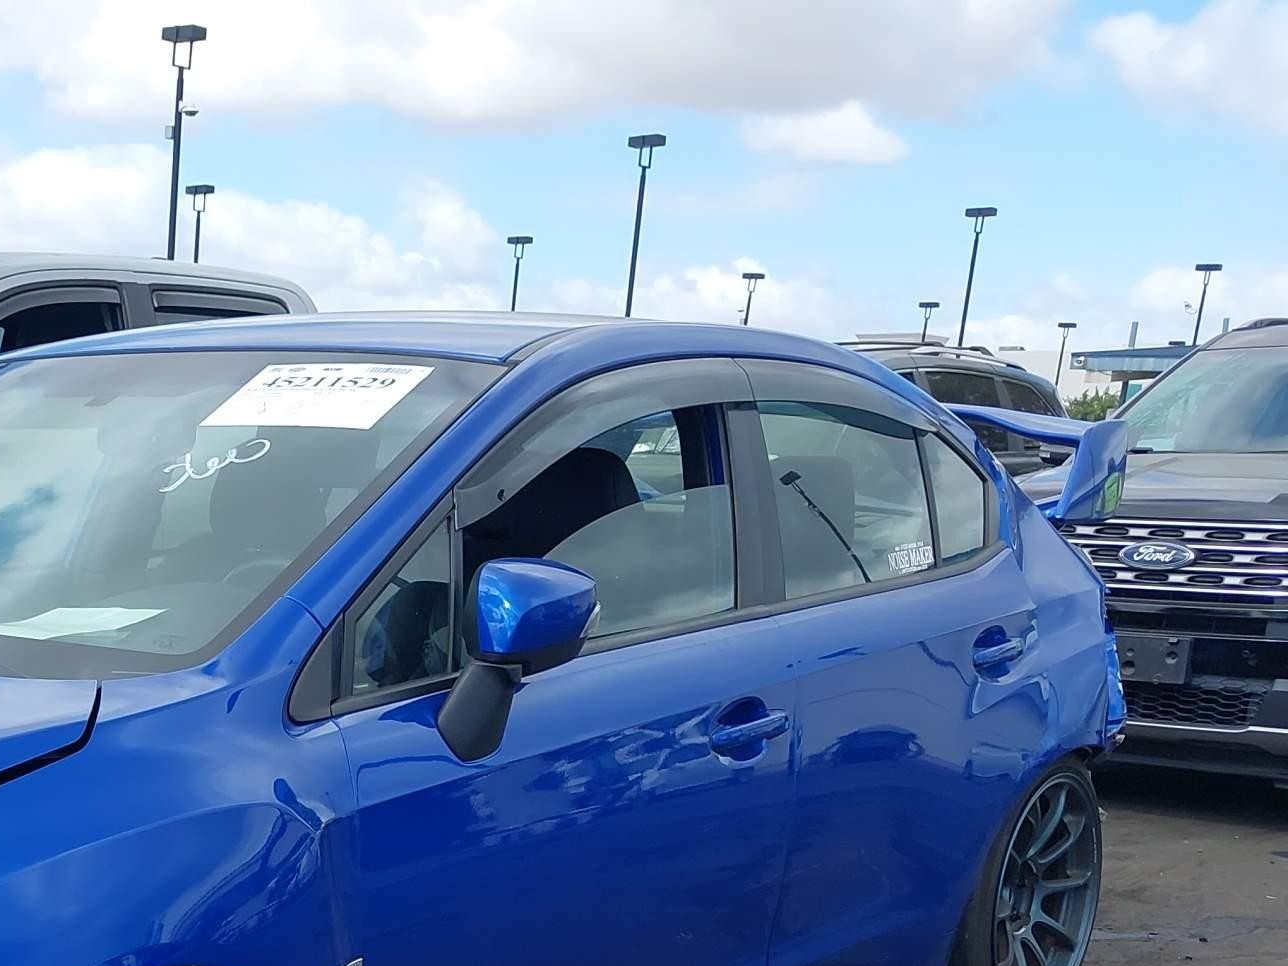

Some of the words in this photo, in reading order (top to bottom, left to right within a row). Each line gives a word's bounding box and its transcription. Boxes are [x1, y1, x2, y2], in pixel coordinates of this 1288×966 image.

[262, 375, 397, 389] 45211529
[887, 550, 910, 571] NOISE
[909, 545, 934, 566] MAKER
[1133, 544, 1178, 563] Ford
